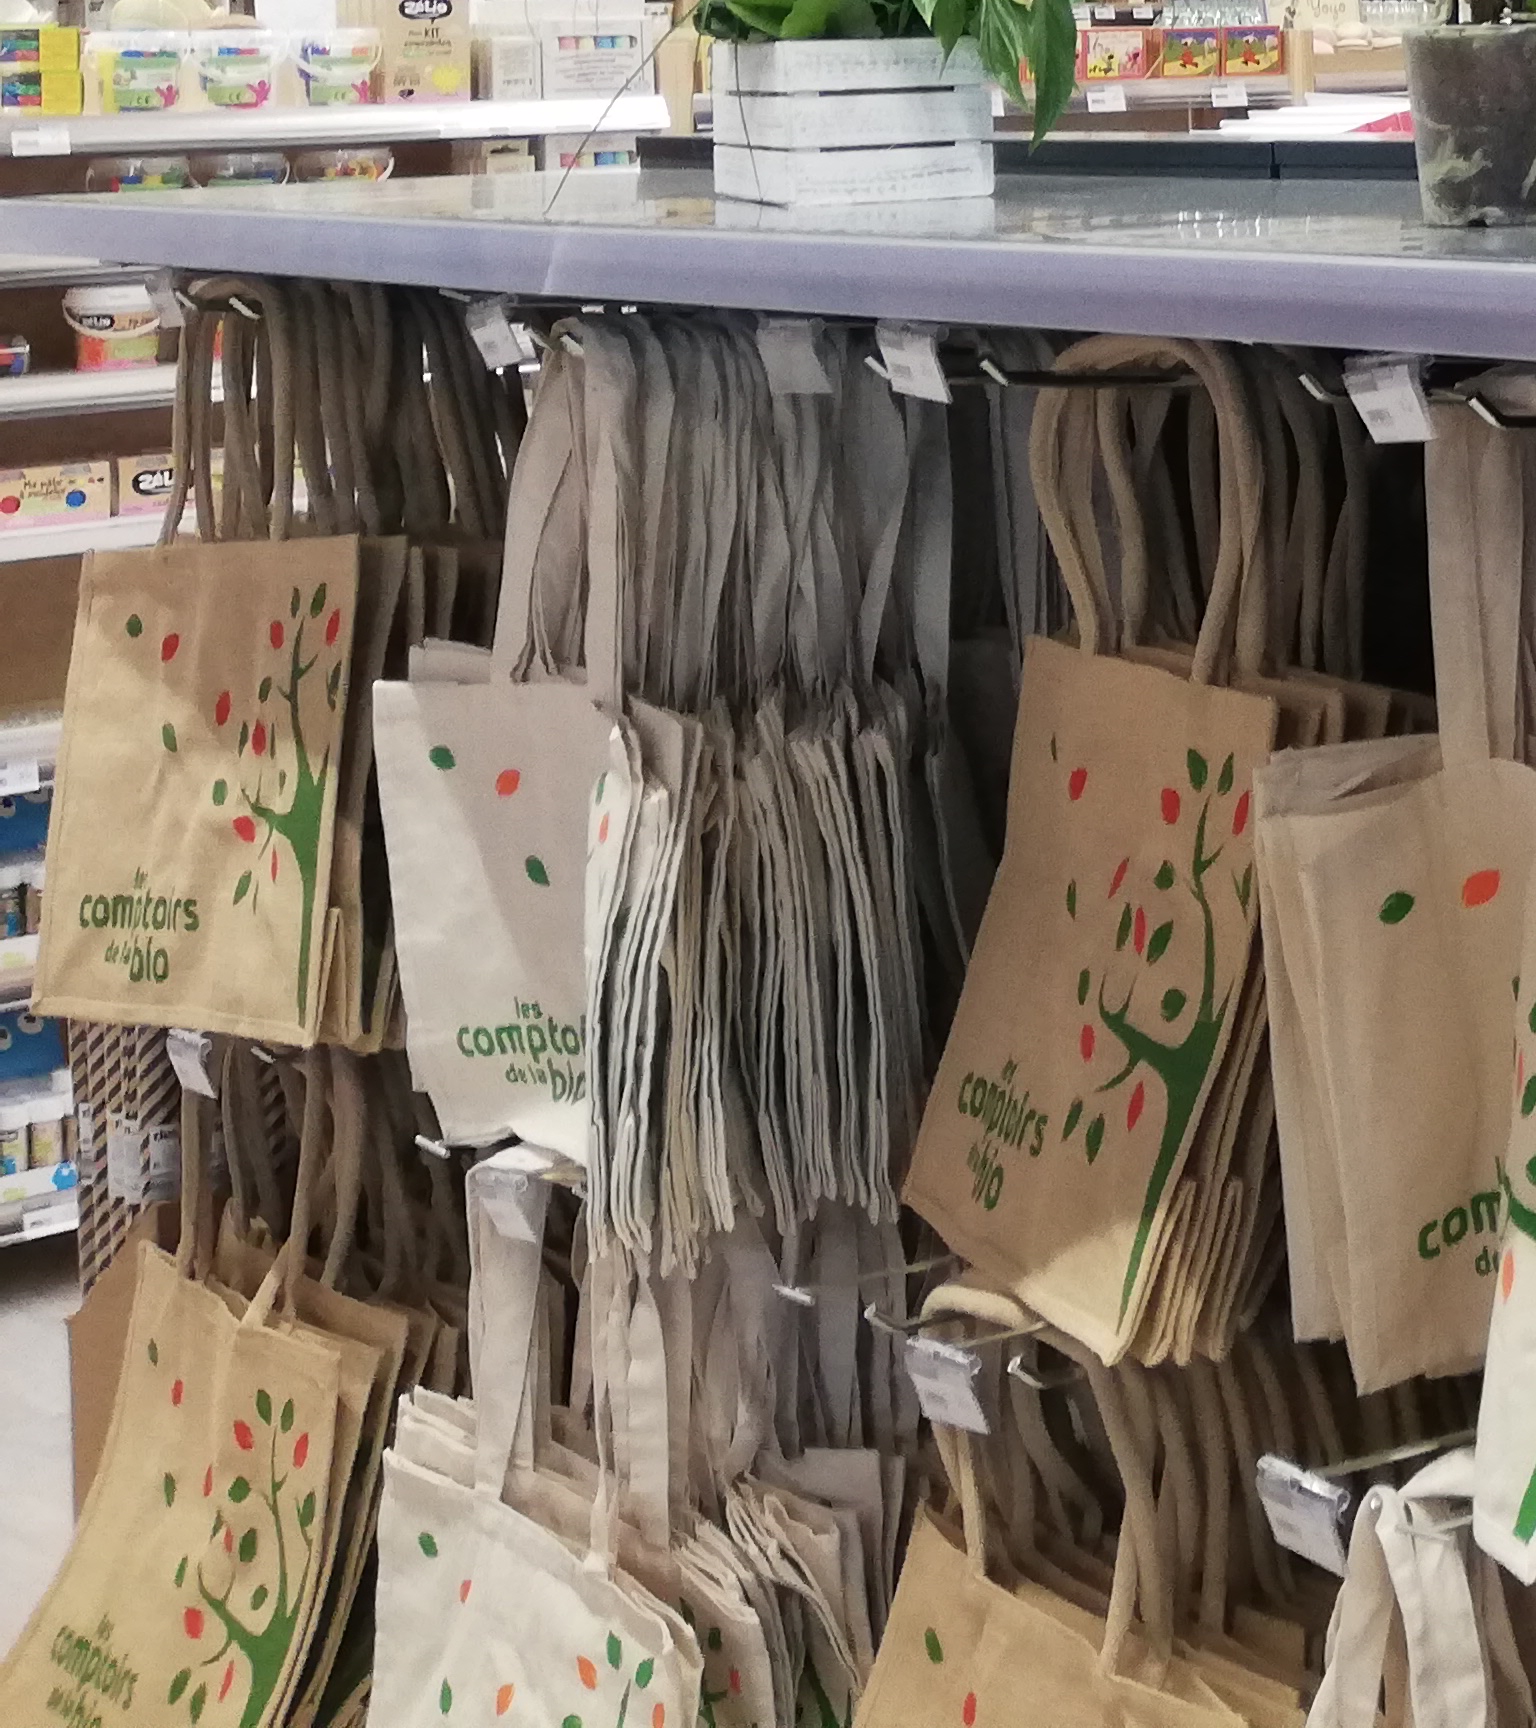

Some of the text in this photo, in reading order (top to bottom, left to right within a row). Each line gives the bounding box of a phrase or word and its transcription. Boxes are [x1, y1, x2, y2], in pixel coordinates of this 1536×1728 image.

[424, 27, 440, 39] KIT
[80, 886, 199, 934] comptoirs
[129, 935, 169, 984] bio
